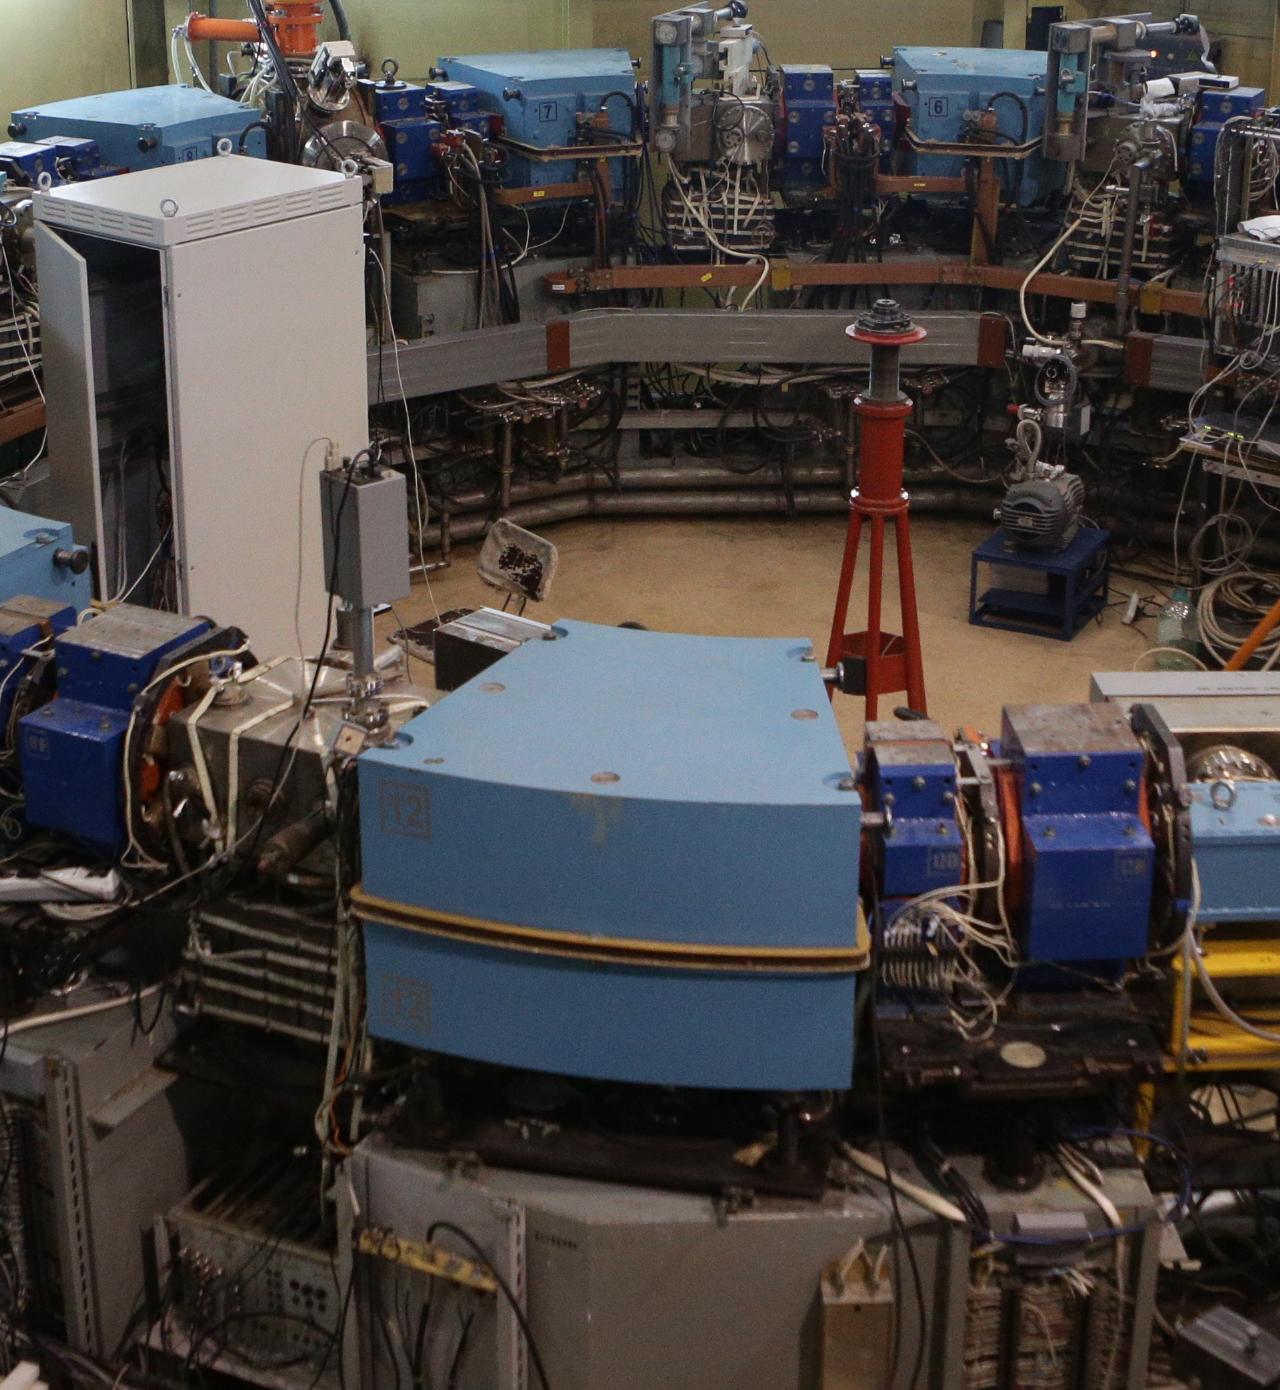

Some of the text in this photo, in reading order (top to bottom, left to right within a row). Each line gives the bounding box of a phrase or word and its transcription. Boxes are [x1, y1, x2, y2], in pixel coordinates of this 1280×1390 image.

[543, 104, 553, 119] 7
[934, 100, 943, 115] 6
[389, 793, 424, 830] 12
